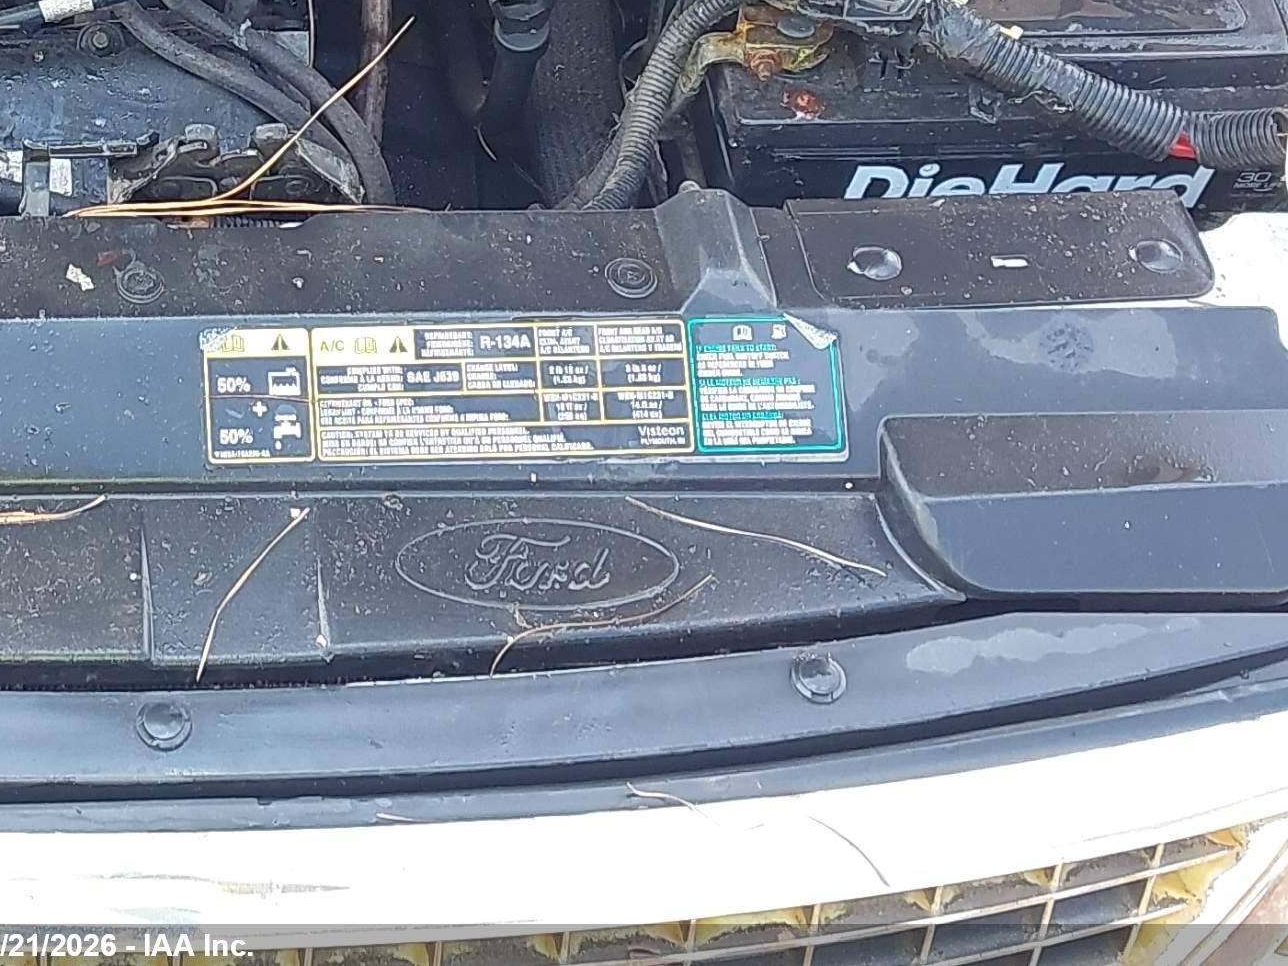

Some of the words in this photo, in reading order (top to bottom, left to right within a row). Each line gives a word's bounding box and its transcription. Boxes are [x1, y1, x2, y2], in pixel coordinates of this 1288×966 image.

[843, 162, 1216, 209] DieHard
[320, 339, 345, 352] A/C
[479, 334, 531, 350] R-134A
[217, 376, 252, 394] 50%
[406, 370, 431, 383] SAE
[219, 427, 254, 445] 50%
[637, 425, 685, 437] Visteon
[464, 533, 611, 591] Ford
